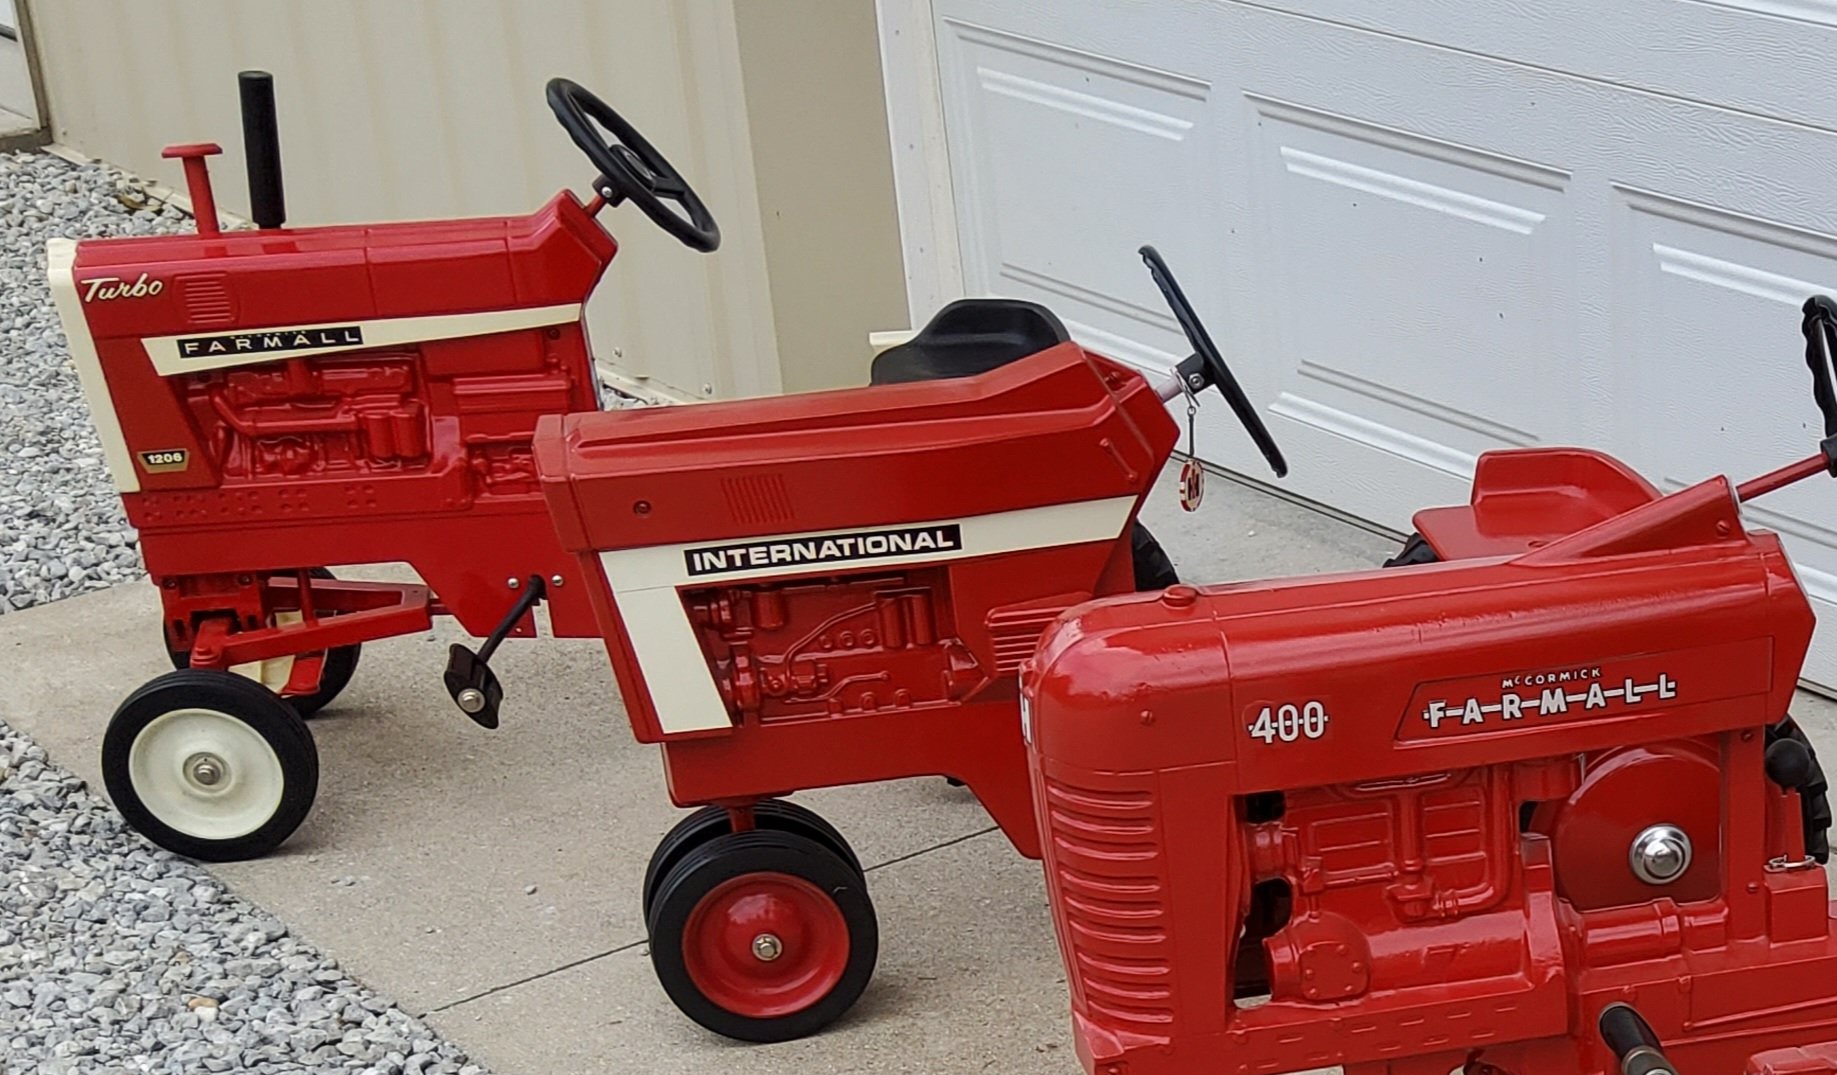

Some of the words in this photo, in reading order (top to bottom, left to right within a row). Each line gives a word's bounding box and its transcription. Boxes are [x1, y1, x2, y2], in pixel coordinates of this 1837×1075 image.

[81, 272, 163, 303] Turbo
[184, 331, 359, 354] FARMALL
[693, 530, 954, 571] INTERNATIONAL
[1248, 701, 1329, 744] 400
